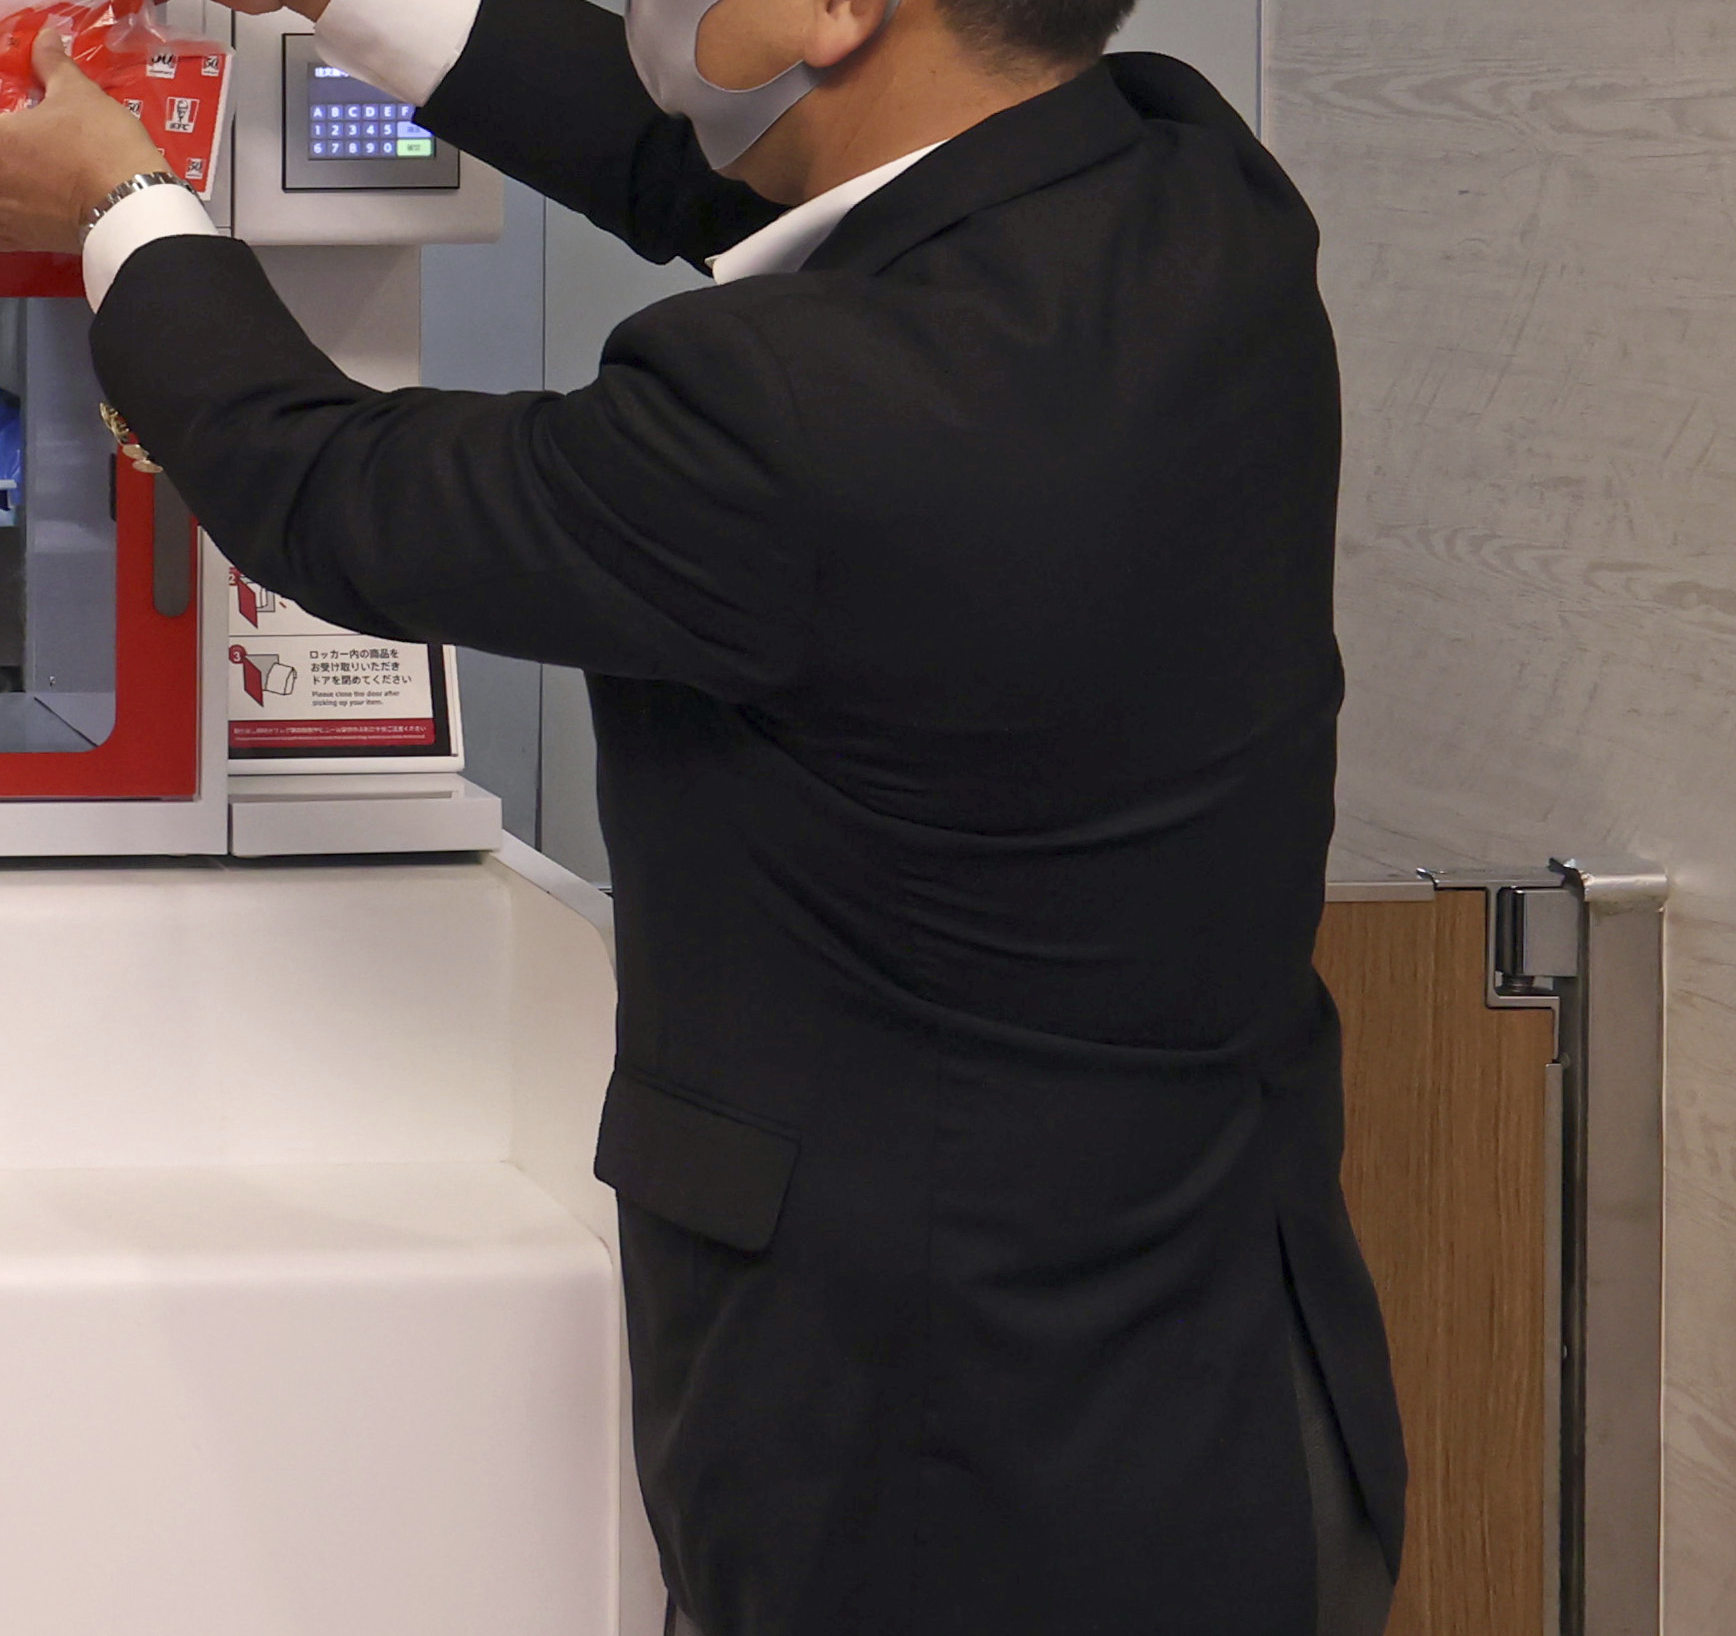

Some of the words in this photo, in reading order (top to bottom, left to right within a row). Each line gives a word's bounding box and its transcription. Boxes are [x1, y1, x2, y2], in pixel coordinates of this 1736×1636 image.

[170, 122, 190, 131] KFC
[233, 652, 241, 662] 3
[309, 649, 399, 660] ロッカー内の商品を
[311, 662, 400, 673] お受け取りいただき
